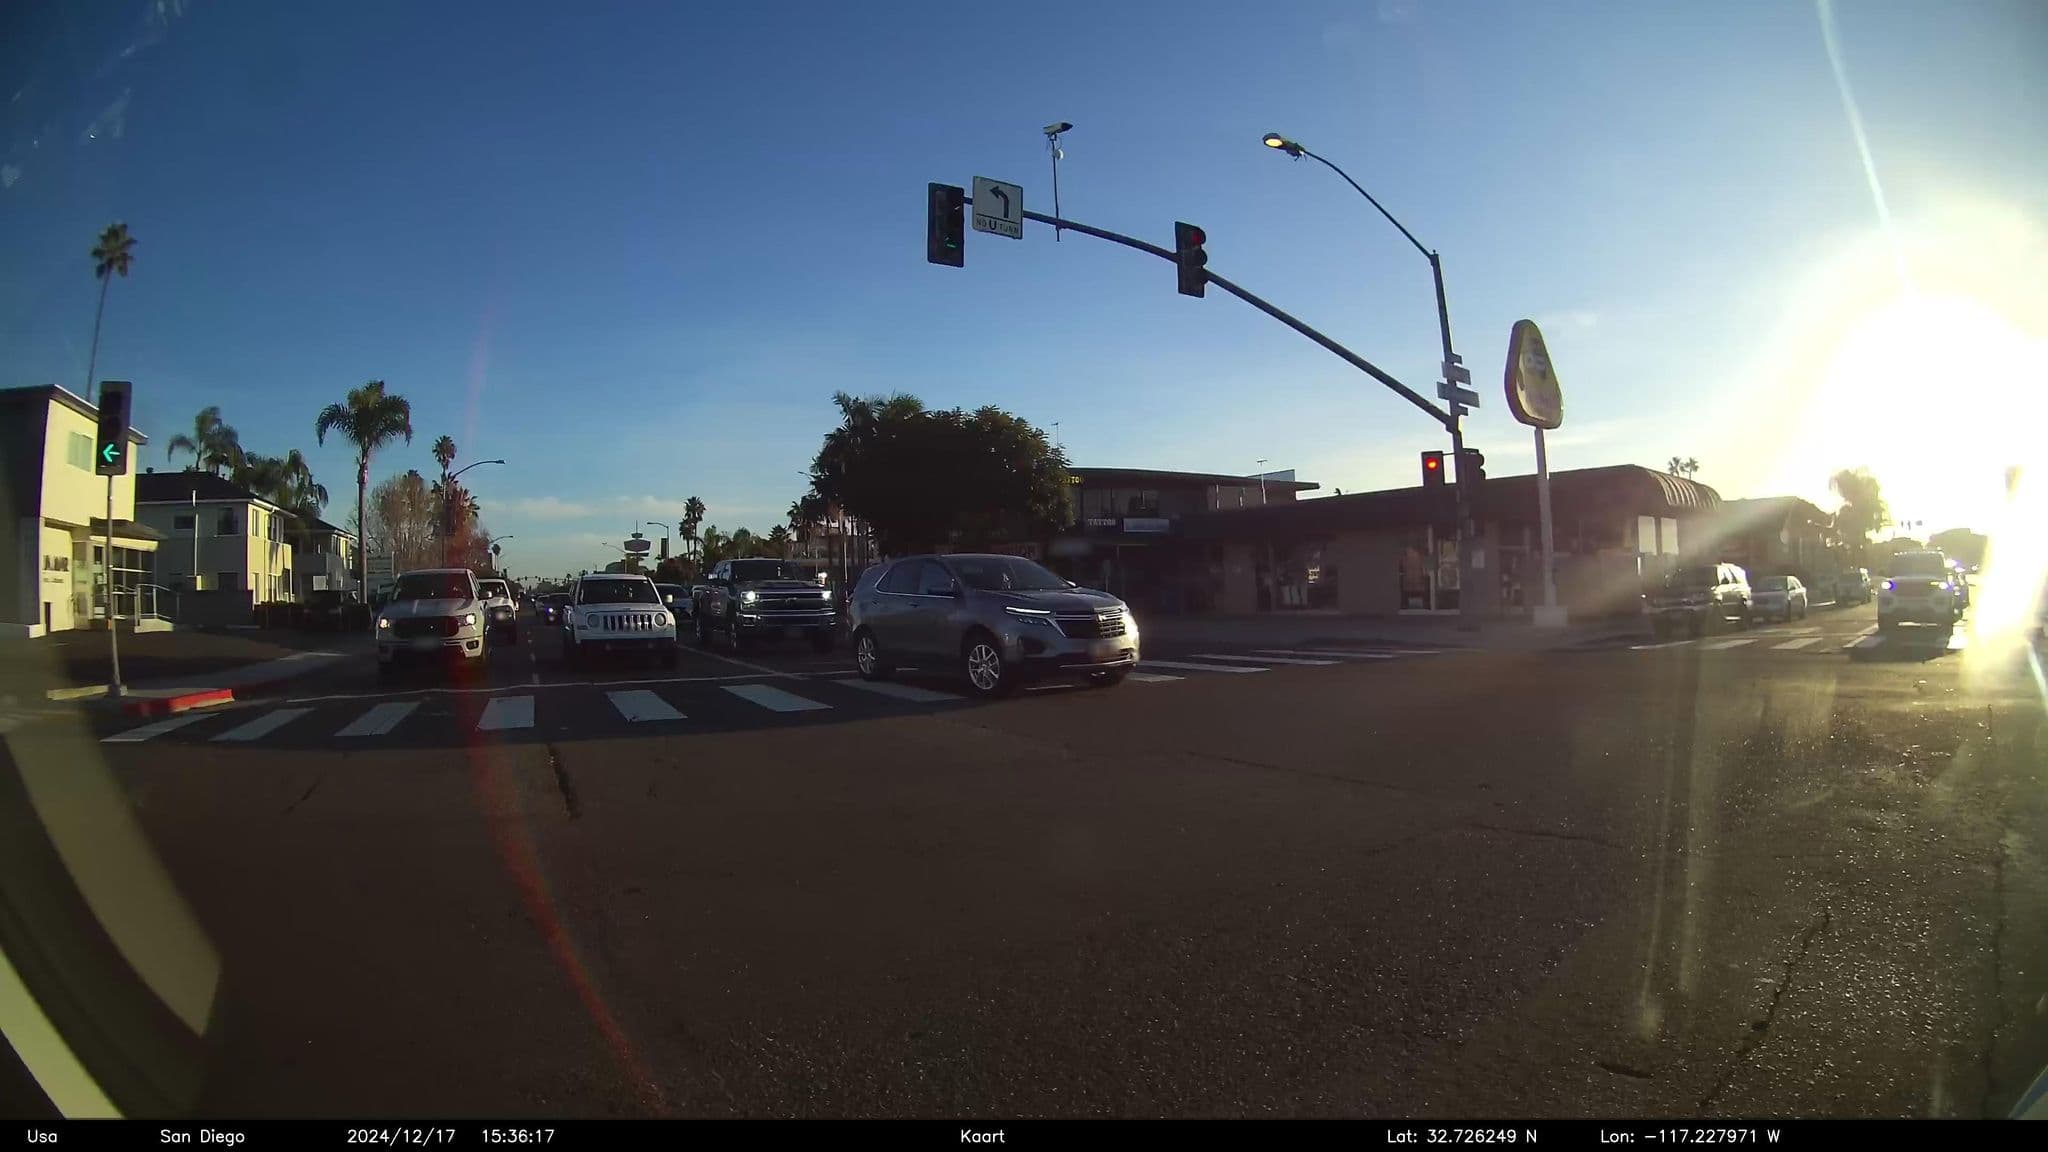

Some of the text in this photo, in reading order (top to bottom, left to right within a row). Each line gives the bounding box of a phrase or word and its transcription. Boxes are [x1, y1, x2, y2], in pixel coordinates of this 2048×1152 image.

[976, 217, 1019, 235] NO U TURN
